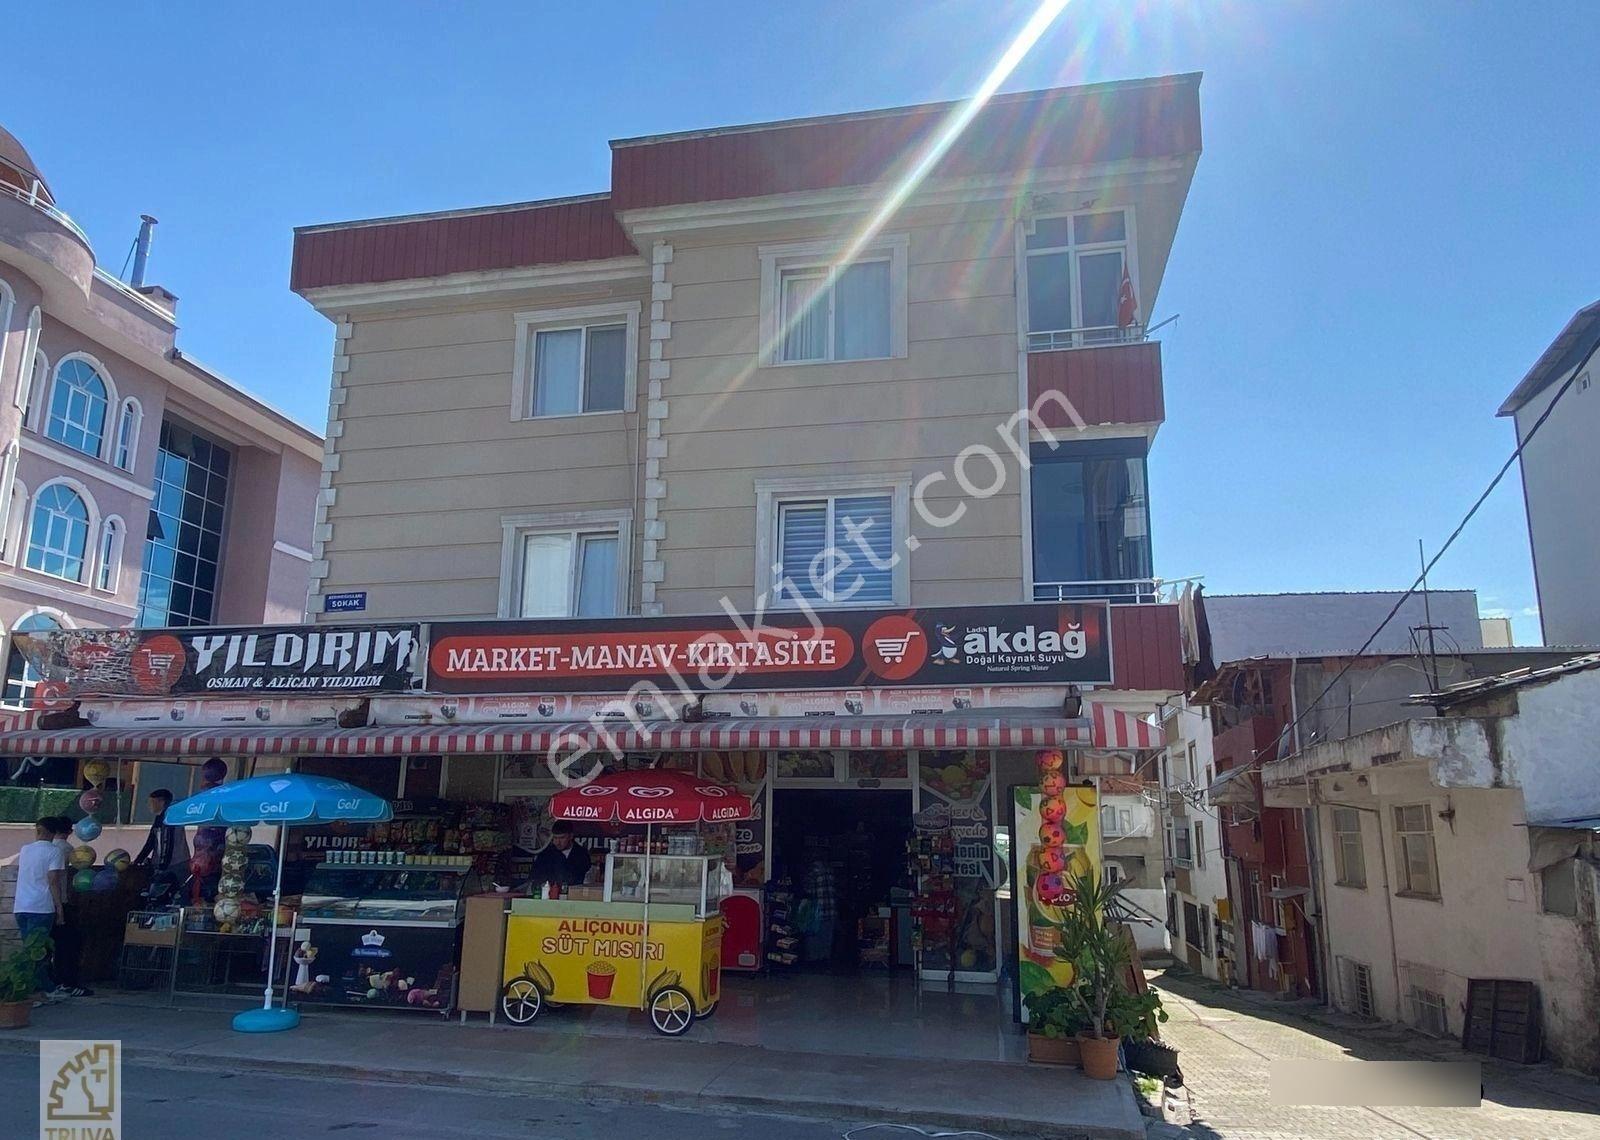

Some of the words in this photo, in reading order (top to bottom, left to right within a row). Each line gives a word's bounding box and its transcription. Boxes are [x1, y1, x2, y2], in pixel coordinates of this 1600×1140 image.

[332, 599, 360, 608] SOKAK
[963, 622, 1087, 659] akdağ
[191, 630, 412, 674] YILDIRIM
[446, 634, 836, 673] MARKET-MANAV-KIRTASİYE
[966, 655, 995, 665] Doğal
[998, 654, 1035, 665] Kaynak
[1038, 654, 1064, 664] Suyu
[1011, 665, 1030, 673] Spring
[206, 677, 252, 689] OSMAN
[253, 678, 263, 688] &
[267, 674, 319, 689] ALİCAN
[321, 675, 384, 688] YILDIRIM
[186, 801, 207, 814] Golf
[259, 801, 289, 814] Golf
[337, 798, 361, 810] Golf
[558, 918, 650, 936] ALİÇONUN
[542, 934, 588, 954] SÜT
[594, 939, 664, 960] MISIRI
